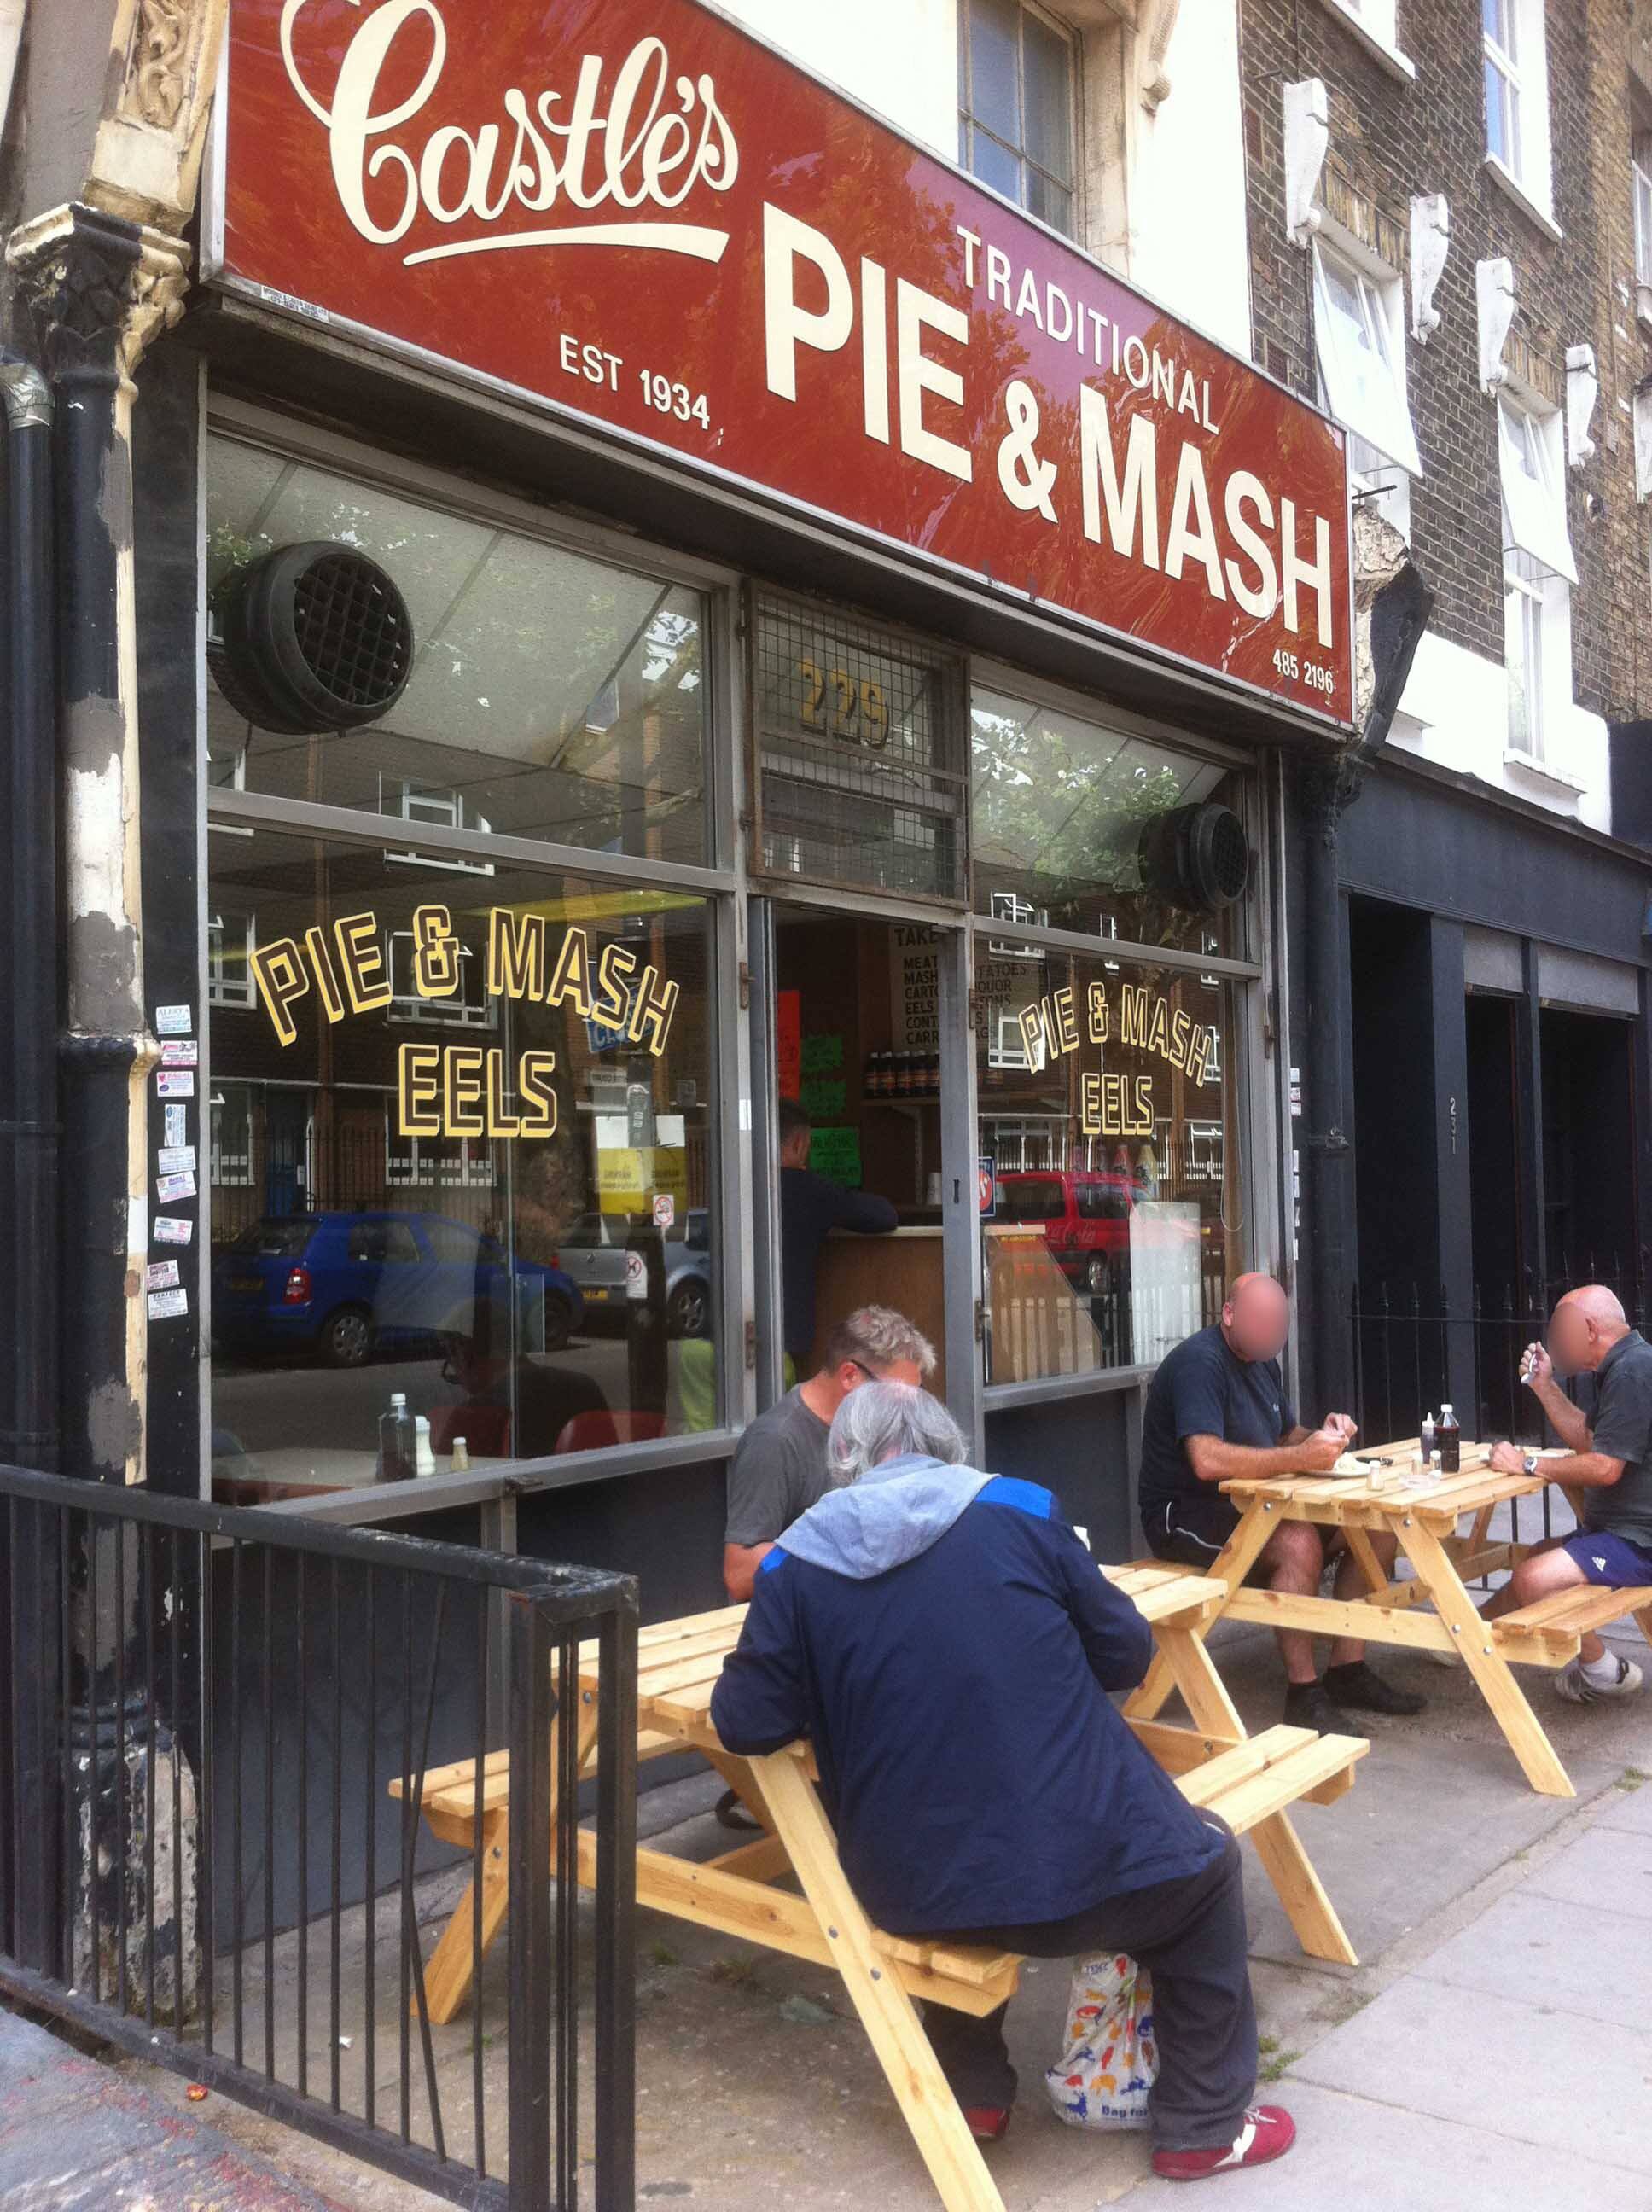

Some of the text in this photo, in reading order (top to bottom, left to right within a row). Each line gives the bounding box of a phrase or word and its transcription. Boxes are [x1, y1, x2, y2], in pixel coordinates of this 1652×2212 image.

[281, 0, 739, 245] Castle's
[956, 224, 1219, 435] TRADITIONAL
[560, 334, 710, 429] EST 1934
[763, 201, 1333, 649] PIE & MASH
[1272, 649, 1333, 694] 485 2196
[249, 905, 679, 1057] PIE & MASH
[905, 1000, 934, 1015] EELS
[1018, 982, 1212, 1088] PIE & MASH
[398, 1043, 557, 1138] EELS
[1081, 1072, 1154, 1136] EELS
